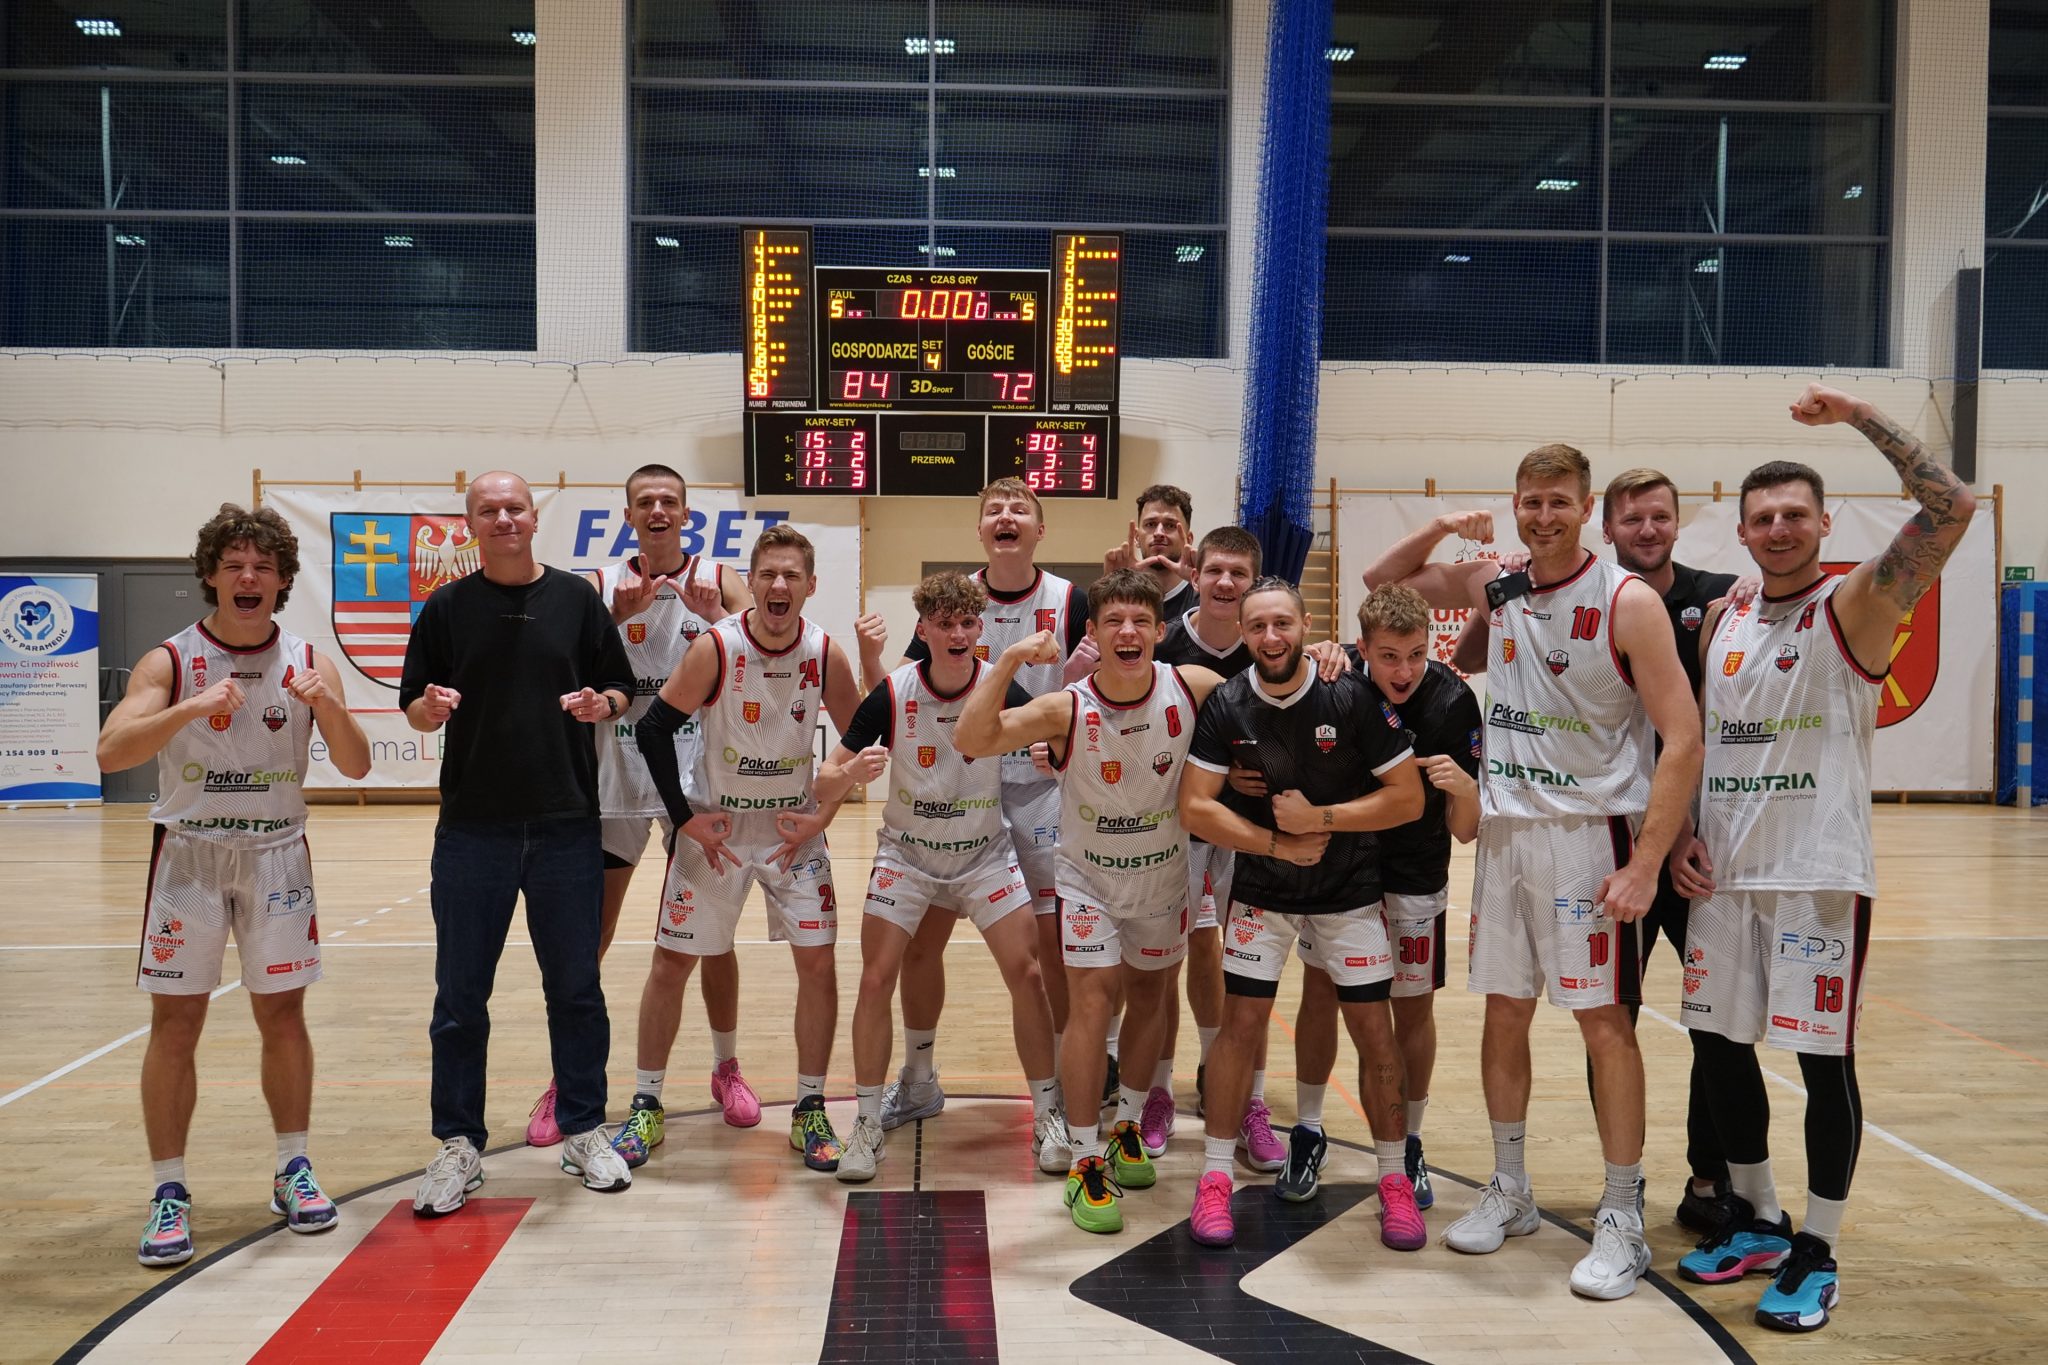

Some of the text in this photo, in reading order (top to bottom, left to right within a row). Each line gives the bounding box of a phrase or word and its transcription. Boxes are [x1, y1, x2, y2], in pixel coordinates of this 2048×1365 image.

[754, 246, 764, 259] 4
[1066, 250, 1075, 264] 3
[756, 273, 765, 287] 8
[887, 275, 912, 283] CZAS
[930, 276, 955, 284] CZAS
[958, 276, 978, 284] GRY
[1065, 278, 1074, 291] 6
[753, 288, 765, 301] 10
[830, 291, 855, 299] FAUL
[1010, 293, 1035, 301] FAUL
[1065, 292, 1074, 306] 8
[753, 301, 765, 314] 11
[830, 300, 843, 318] 5
[1022, 302, 1034, 320] 5
[754, 314, 766, 328] 13
[754, 329, 766, 342] 14
[832, 342, 917, 359] GOSPODARZE
[922, 341, 943, 349] SET
[967, 340, 1014, 360] GOŚCIE
[927, 354, 939, 369] 4
[750, 368, 767, 382] 24
[750, 382, 767, 396] 30
[844, 371, 888, 398] 84
[993, 373, 1033, 400] 72
[805, 418, 856, 426] KARY-SETY
[1036, 421, 1086, 430] KARY-SETY
[851, 432, 864, 448] 2
[1083, 436, 1094, 450] 4
[851, 452, 864, 467] 2
[1082, 454, 1094, 470] 5
[852, 471, 864, 487] 3
[1082, 473, 1093, 489] 5
[1034, 609, 1056, 633] 15
[1570, 606, 1601, 641] 10
[3, 628, 68, 651] SKY PARAMEDIC
[1724, 662, 1736, 673] CK
[212, 716, 226, 728] CK
[1165, 705, 1182, 738] 8
[1722, 714, 1822, 735] PakarService
[920, 755, 931, 765] CK
[1103, 770, 1117, 781] CK
[1489, 759, 1580, 786] DUSTRIA
[1709, 772, 1816, 792] INDUSTRIA
[1084, 844, 1179, 869] INDUSTRIA
[666, 900, 695, 912] KURNIK
[308, 914, 319, 945] 4
[1232, 917, 1264, 931] KURNIK
[148, 934, 185, 946] KURNIK
[1399, 937, 1429, 964] 30
[1587, 932, 1608, 967] 10
[1814, 974, 1844, 1013] 13
